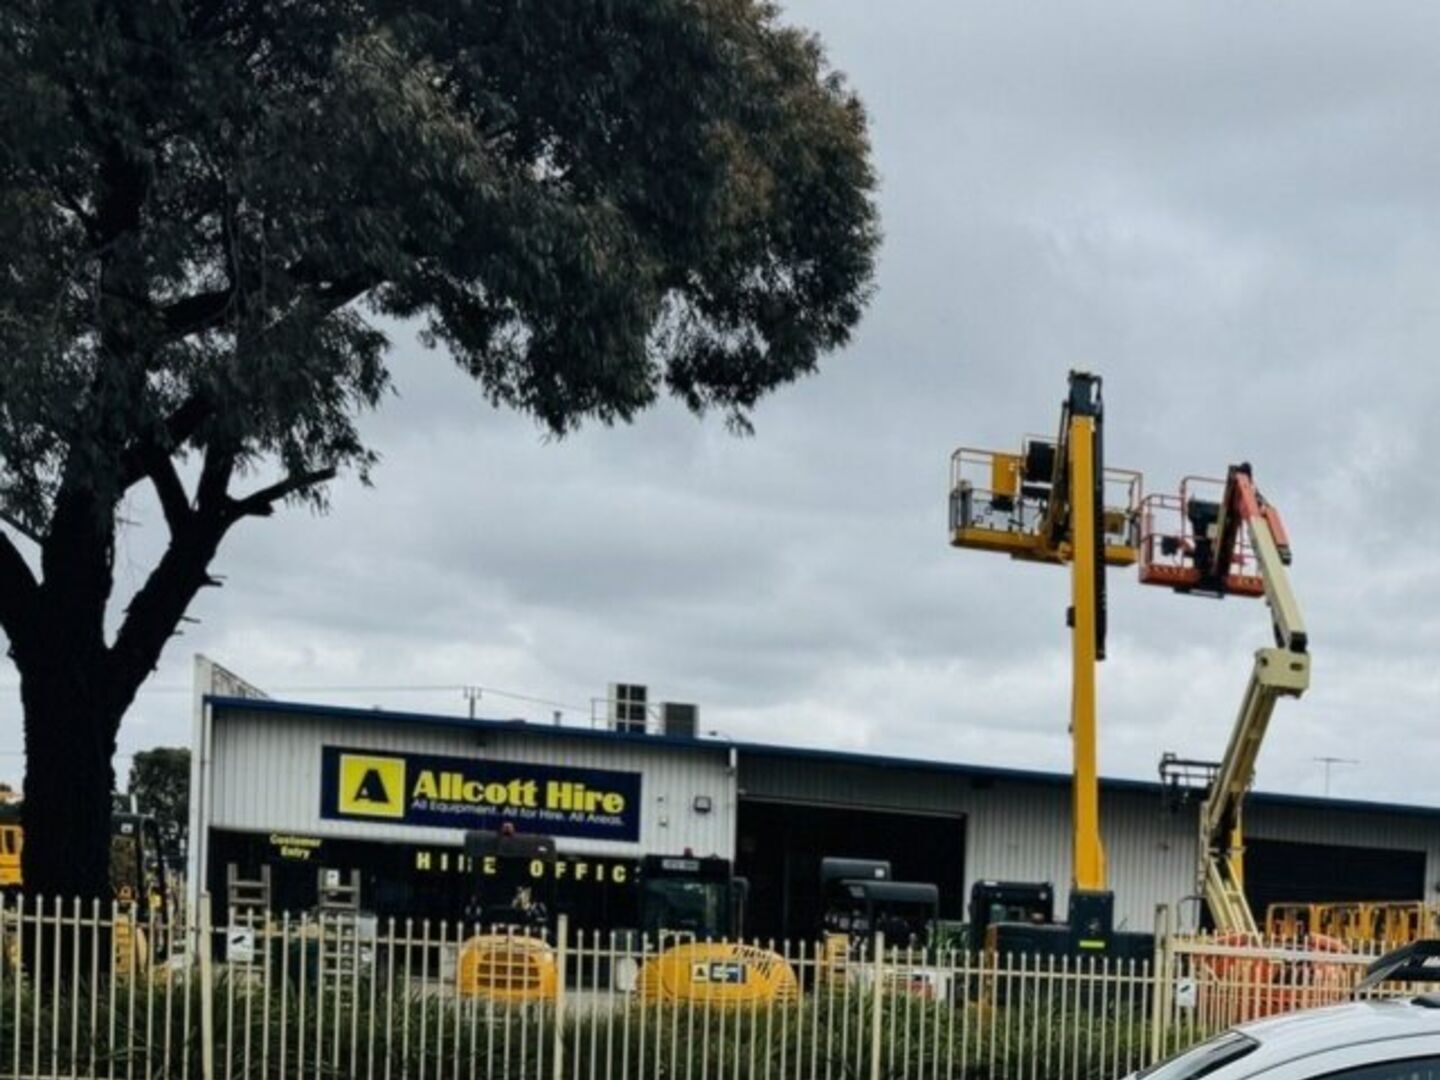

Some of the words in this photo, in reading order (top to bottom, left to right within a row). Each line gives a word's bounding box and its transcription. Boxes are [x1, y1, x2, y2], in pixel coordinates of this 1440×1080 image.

[413, 770, 537, 807] Allcott
[546, 781, 625, 814] Hire
[269, 834, 323, 848] Customer
[280, 846, 311, 860] Entry
